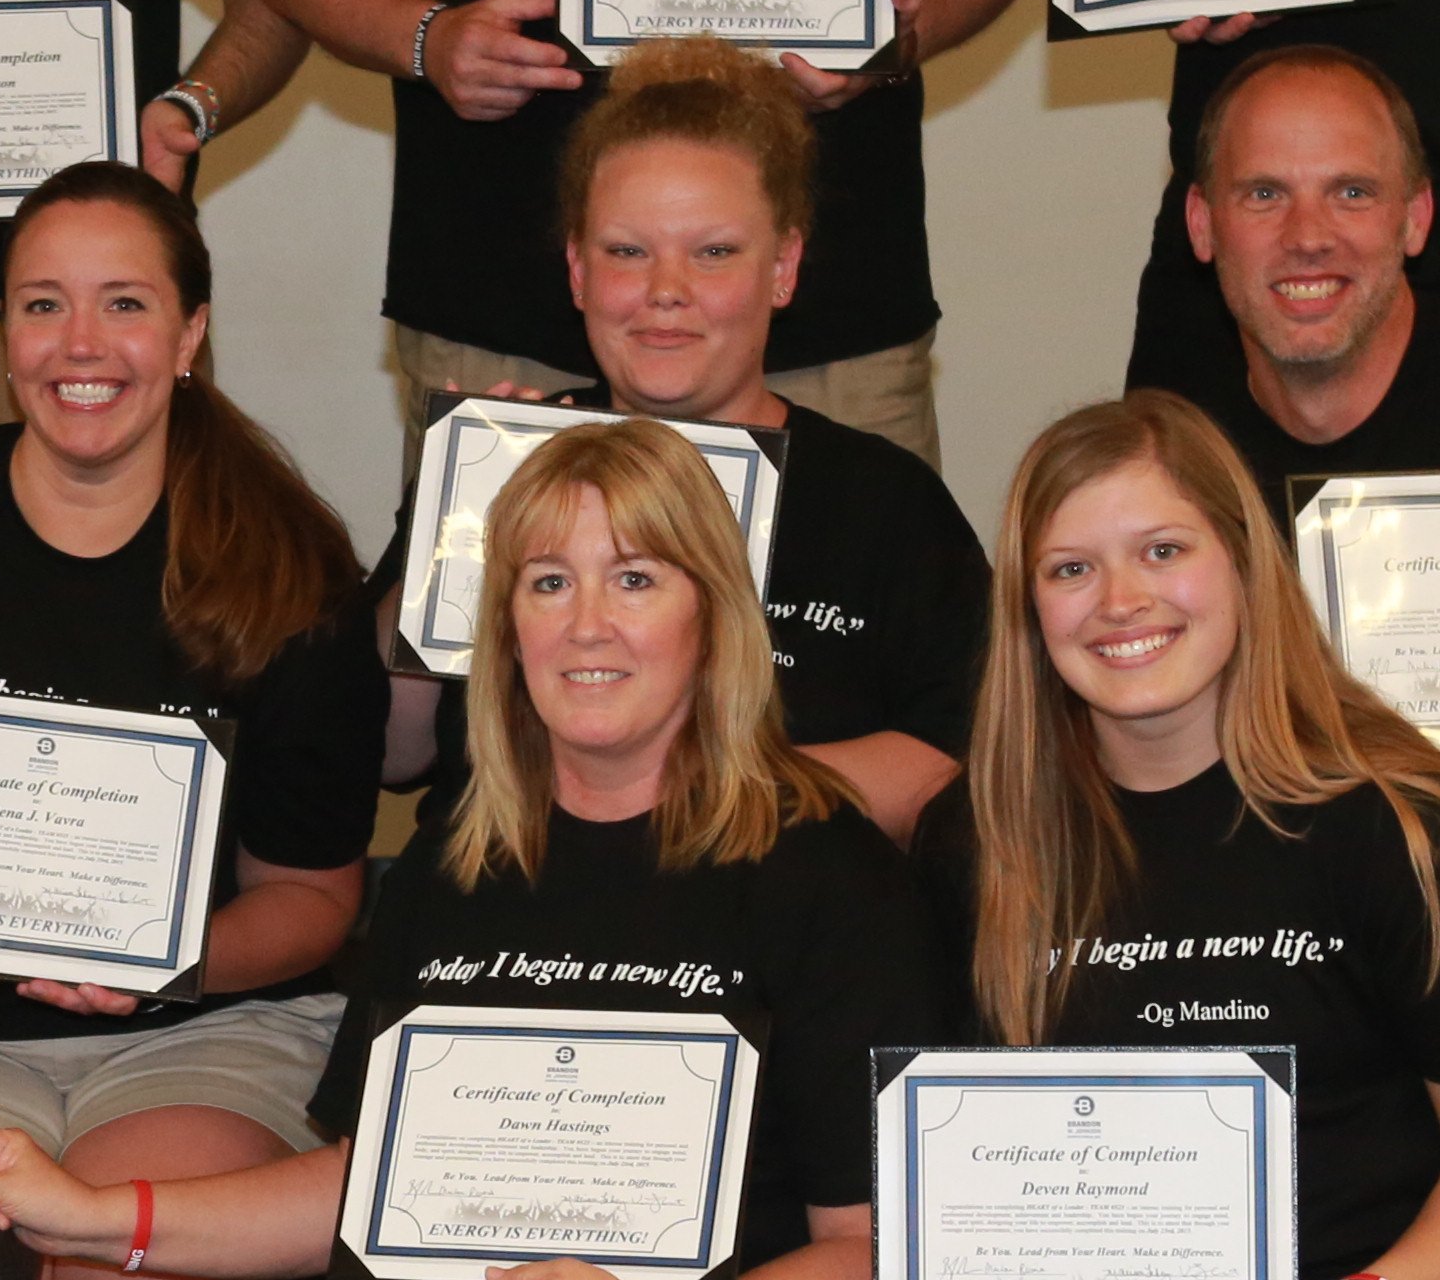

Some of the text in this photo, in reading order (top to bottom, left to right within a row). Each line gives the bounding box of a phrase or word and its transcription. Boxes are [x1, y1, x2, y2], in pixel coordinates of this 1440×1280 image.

[1068, 939, 1085, 967] I
[1088, 934, 1167, 970] begin
[1177, 939, 1194, 958] a
[1203, 937, 1264, 957] new
[487, 952, 510, 977] I
[509, 953, 583, 985] begin
[589, 963, 607, 980] a
[611, 964, 668, 984] new
[1137, 999, 1269, 1027] -Og Mandino
[453, 1086, 665, 1107] Certificate of Completion
[972, 1146, 1197, 1166] Certificate of Completion
[429, 1224, 648, 1243] ENERGY IS EVERYTHING!
